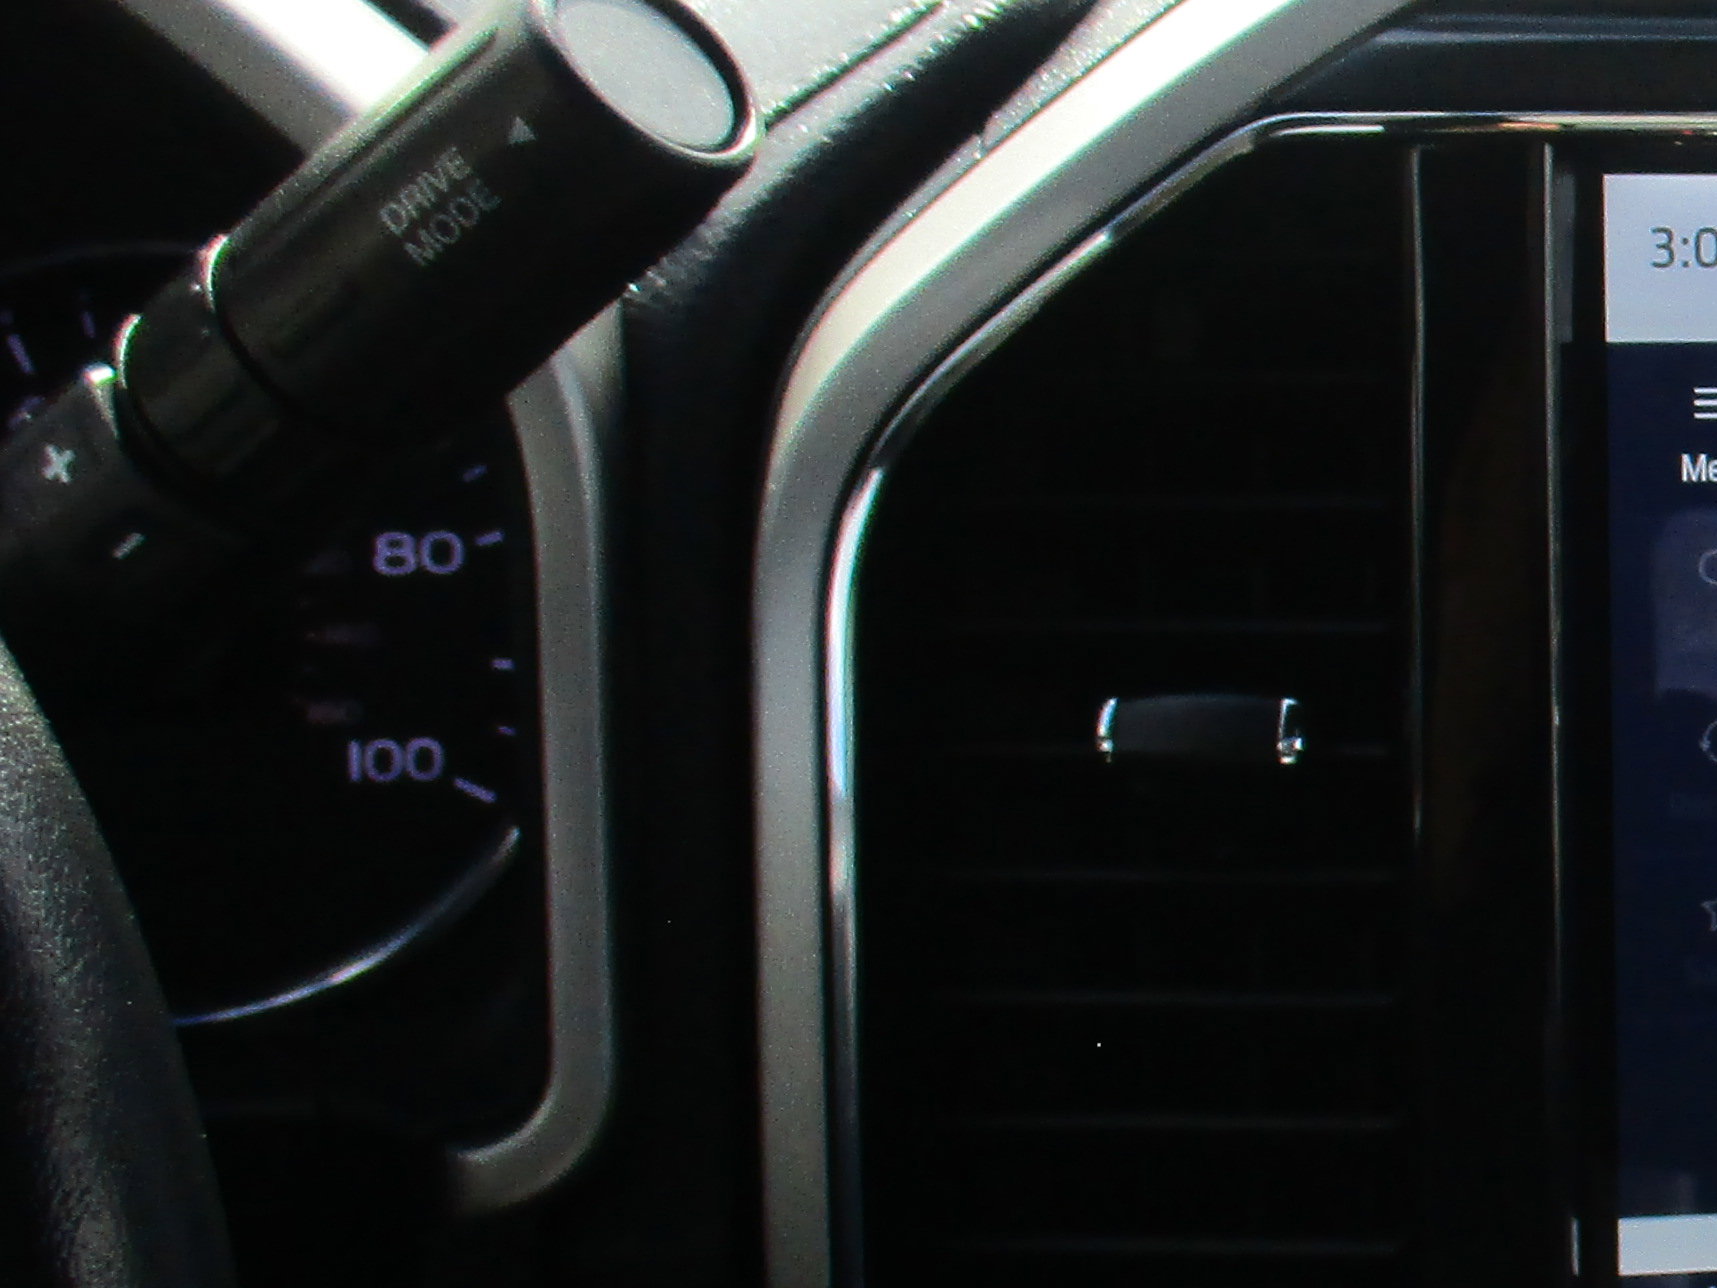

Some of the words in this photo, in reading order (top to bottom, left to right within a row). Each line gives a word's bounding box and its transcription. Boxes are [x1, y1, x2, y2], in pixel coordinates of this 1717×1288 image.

[380, 147, 471, 237] DRIVE
[404, 178, 502, 266] MODE
[373, 532, 464, 575] 80
[348, 738, 444, 782] 100
